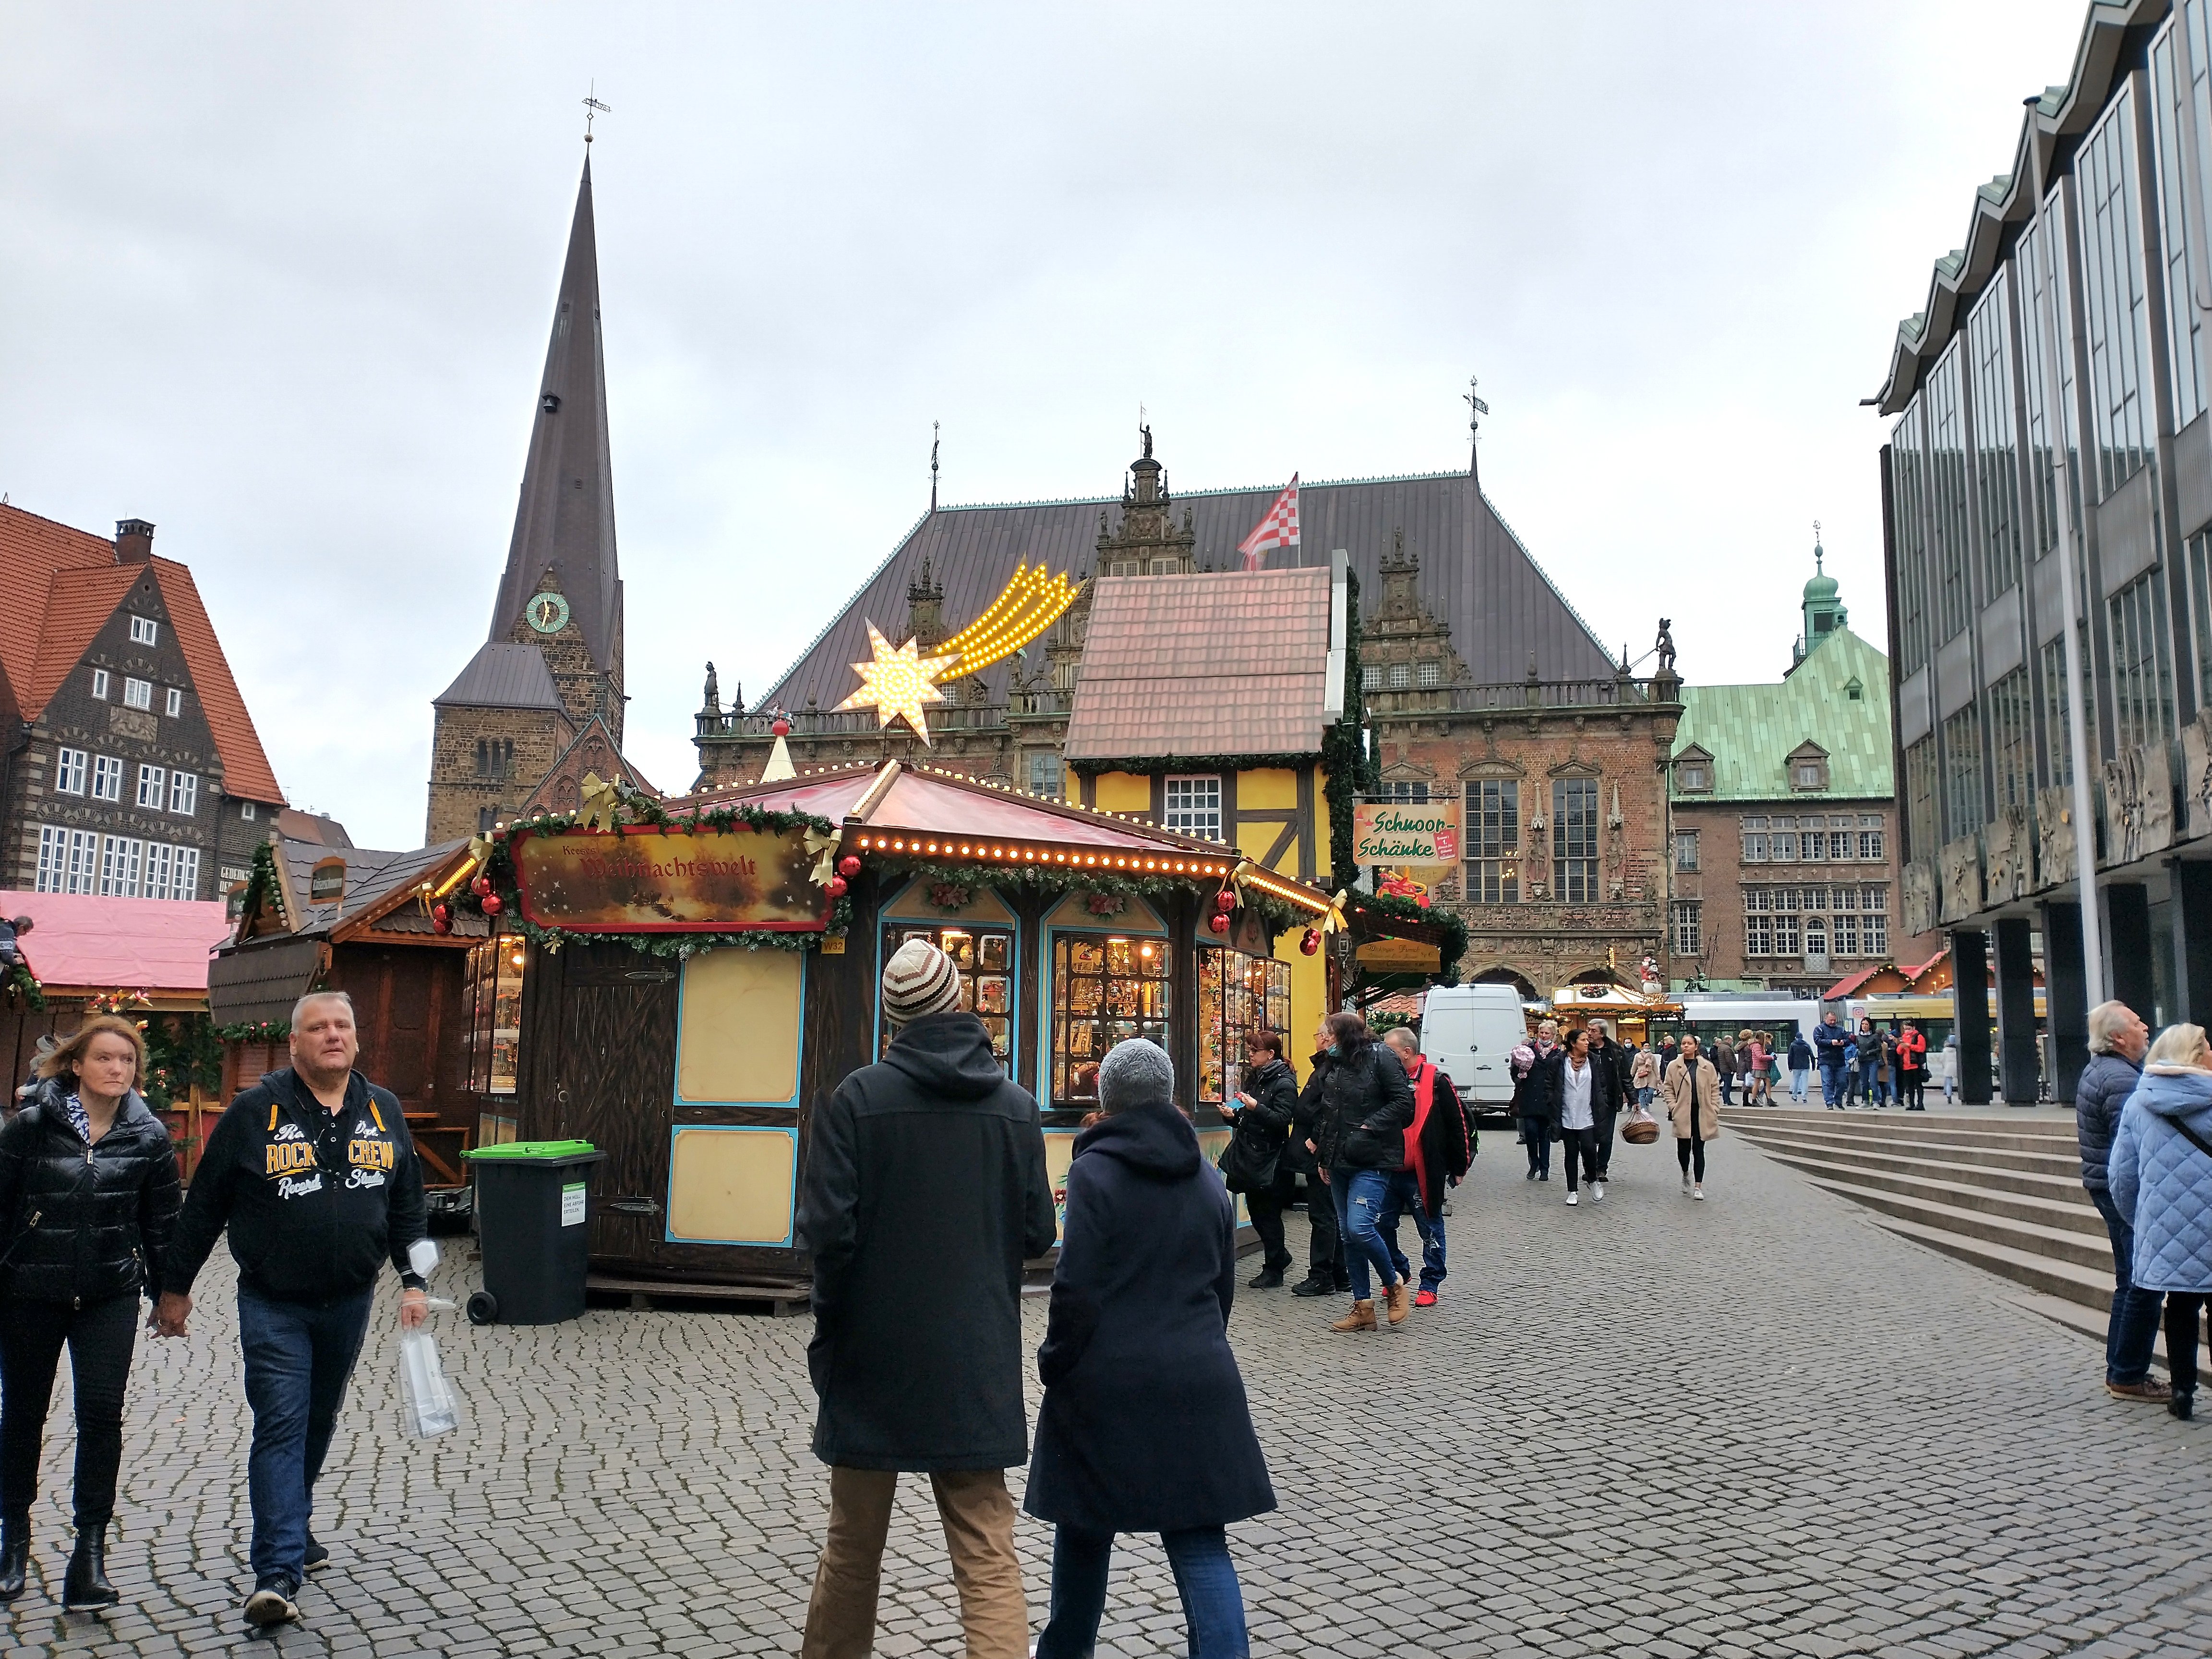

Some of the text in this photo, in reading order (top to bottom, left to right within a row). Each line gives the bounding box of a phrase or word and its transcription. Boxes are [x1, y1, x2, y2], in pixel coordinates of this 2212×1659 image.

[1373, 811, 1456, 833] Schnoor-
[563, 846, 597, 855] Keeses
[1357, 838, 1435, 857] Schänke
[579, 855, 756, 878] Weihnachtswelt
[824, 942, 843, 950] W32
[266, 1140, 394, 1174] ROCK CREW
